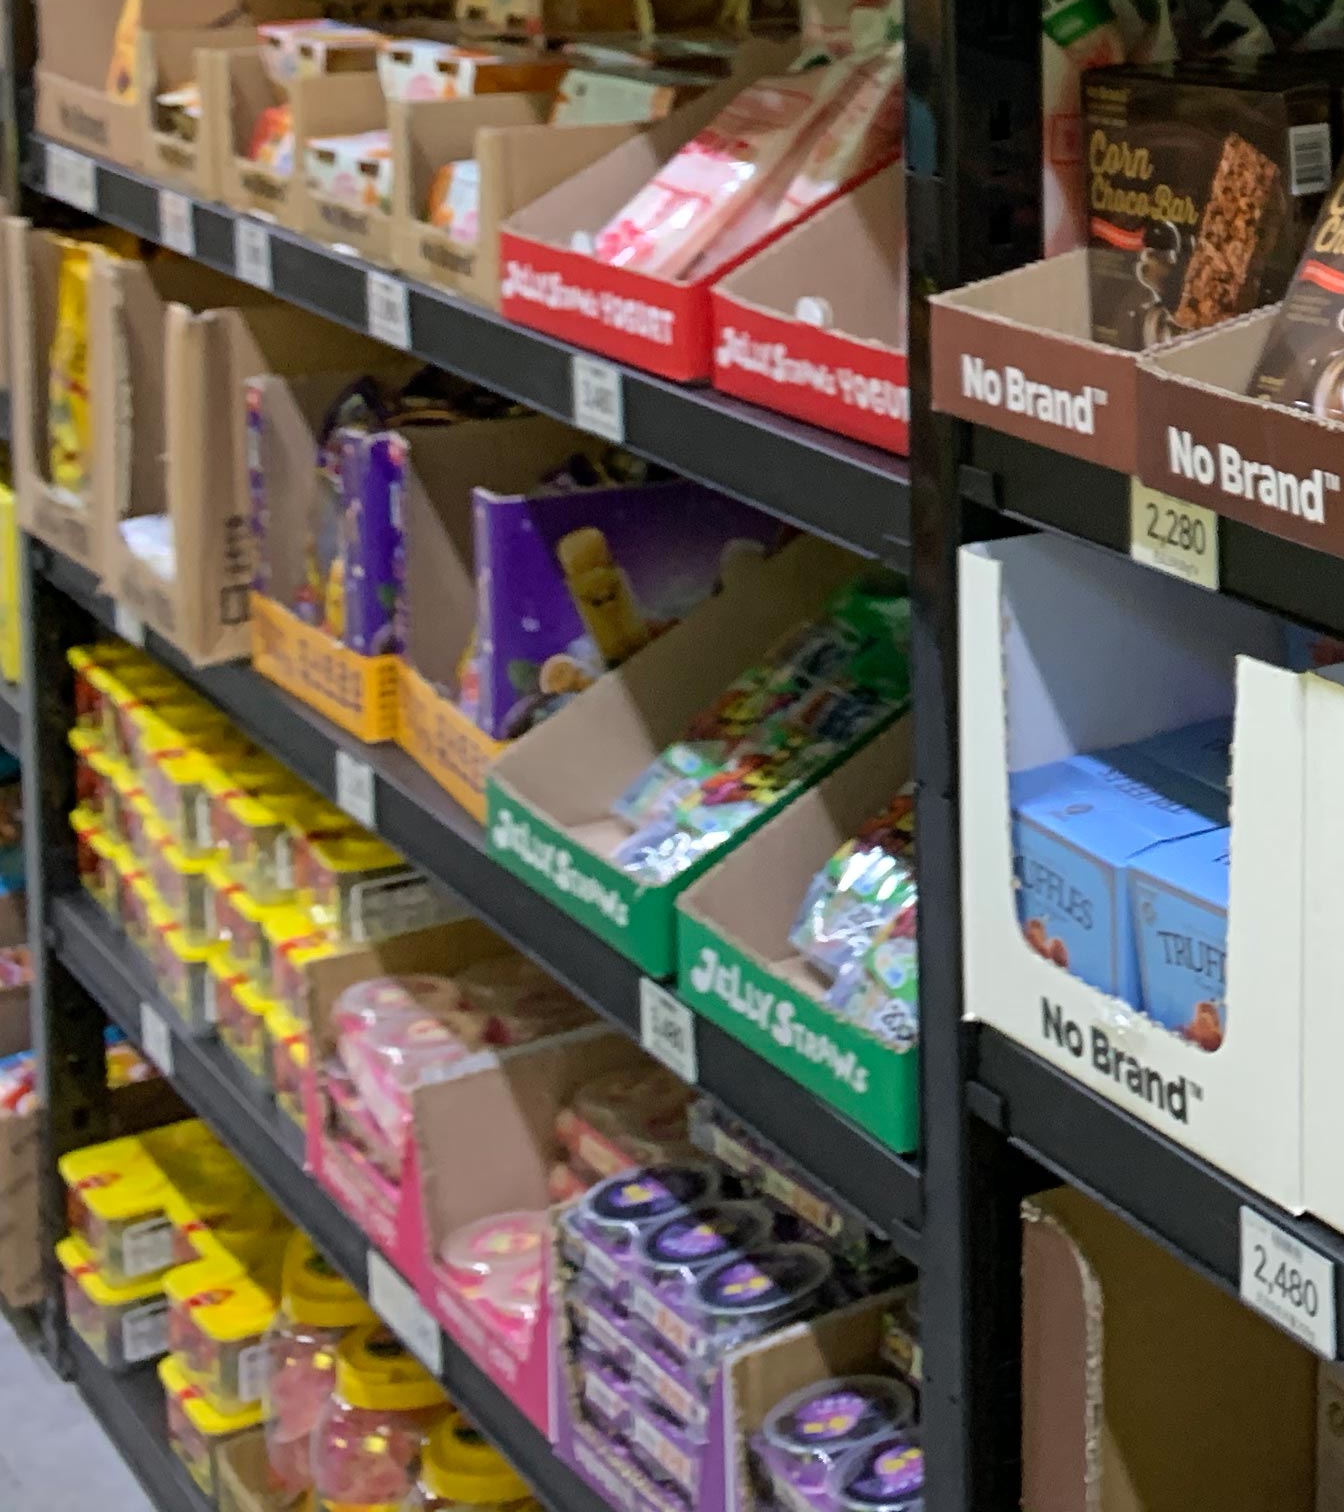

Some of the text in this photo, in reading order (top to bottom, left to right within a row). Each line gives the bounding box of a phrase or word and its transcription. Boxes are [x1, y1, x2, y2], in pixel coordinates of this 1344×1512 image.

[1089, 129, 1153, 183] Corn
[960, 353, 997, 401] No
[1166, 426, 1215, 486] No
[1146, 502, 1206, 556] 2,280
[690, 947, 773, 1029] JELLY
[1041, 996, 1085, 1062] No
[1254, 1244, 1318, 1317] 2,480
